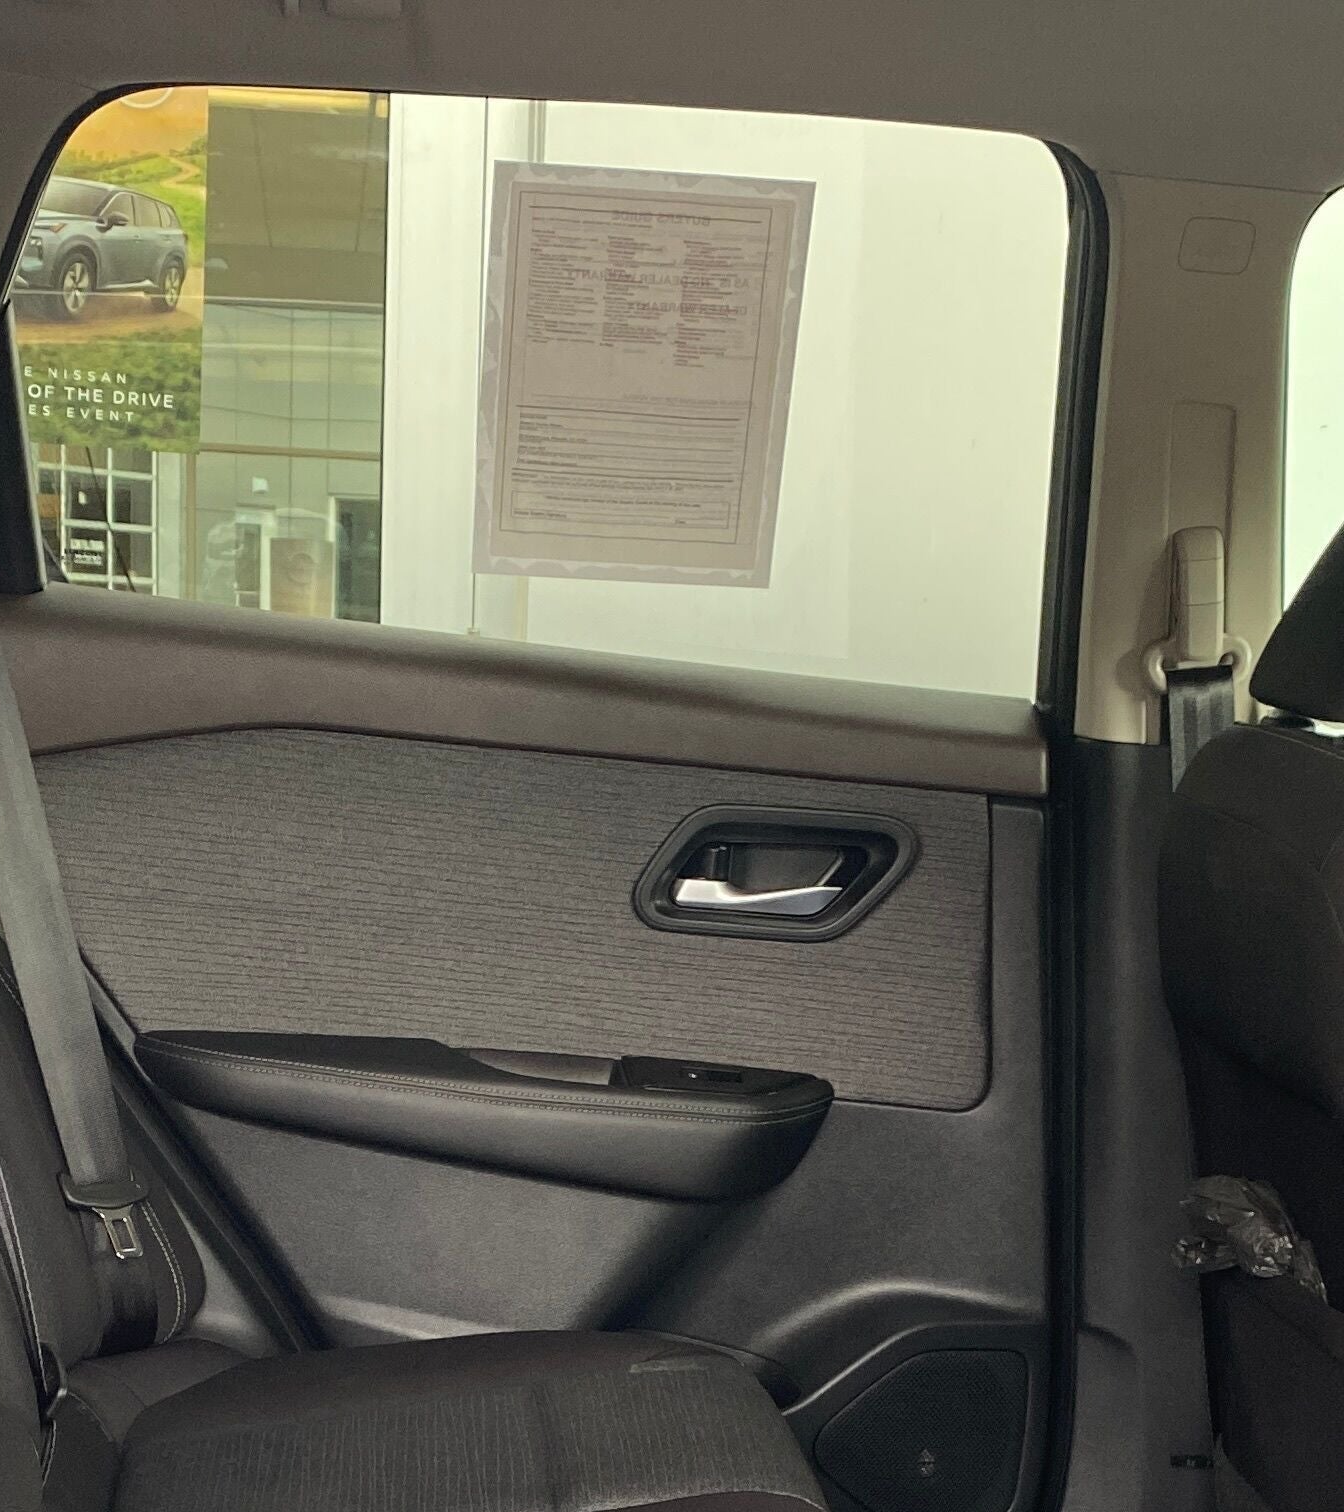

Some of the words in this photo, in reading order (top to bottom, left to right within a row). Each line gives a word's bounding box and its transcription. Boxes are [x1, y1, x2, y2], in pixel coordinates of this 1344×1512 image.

[47, 367, 127, 384] NISSAN
[27, 384, 55, 399] OF
[64, 386, 104, 403] THE
[112, 390, 174, 409] DRIVE
[66, 406, 135, 423] EVENT
